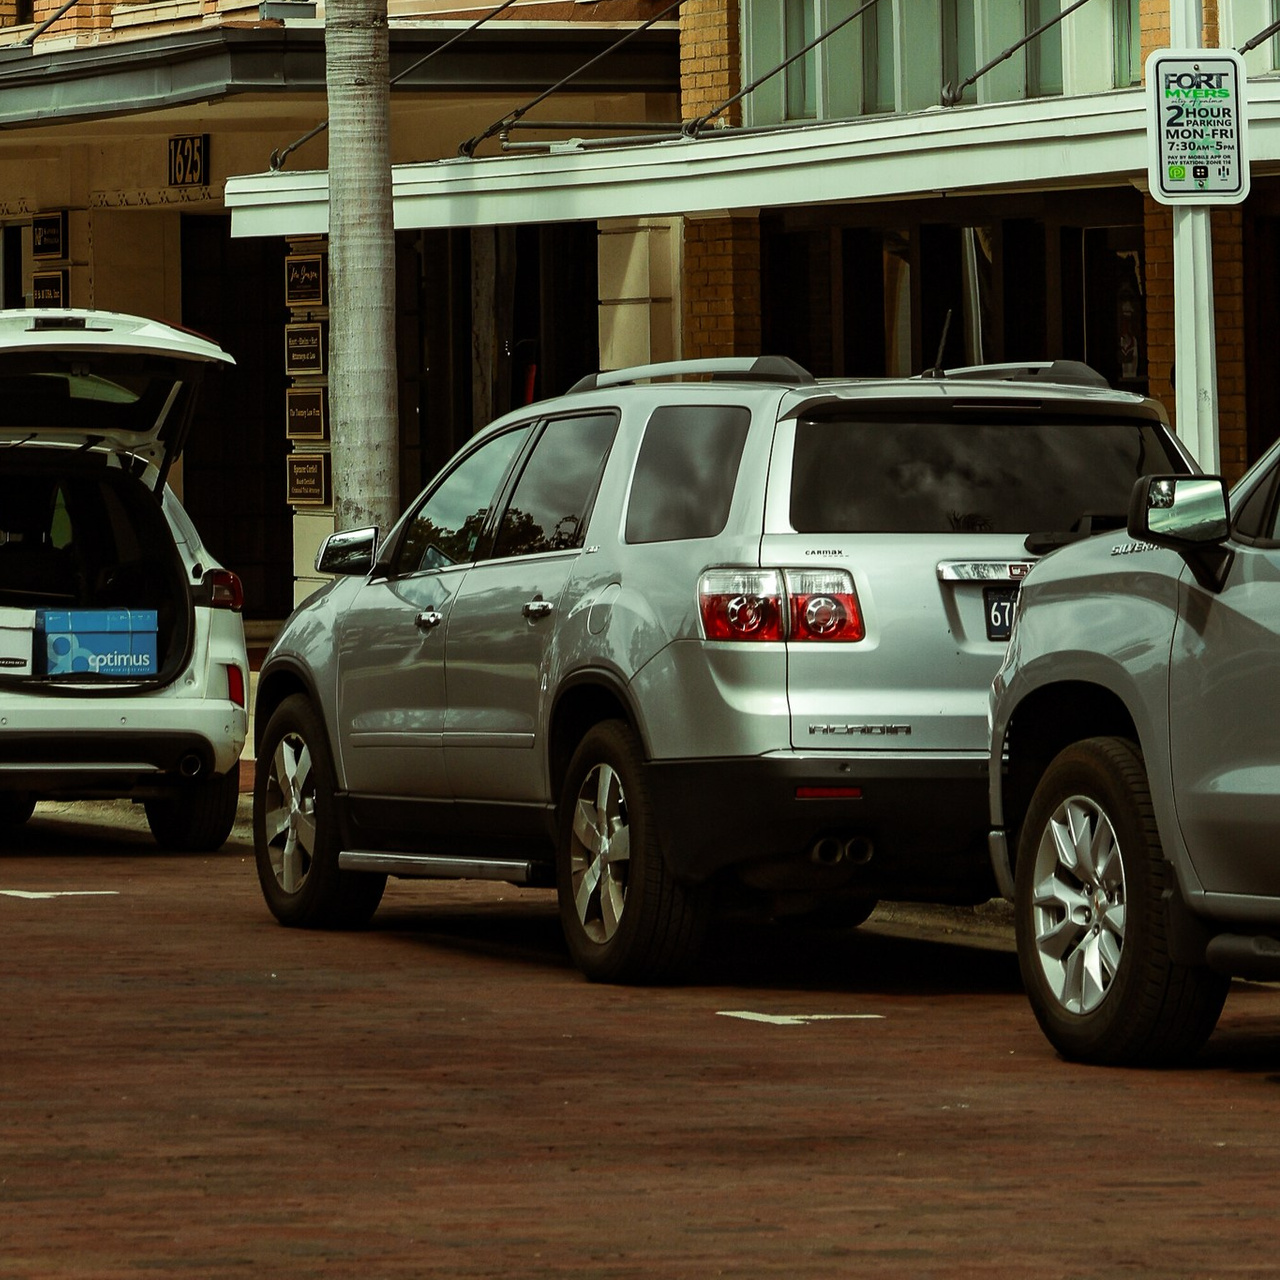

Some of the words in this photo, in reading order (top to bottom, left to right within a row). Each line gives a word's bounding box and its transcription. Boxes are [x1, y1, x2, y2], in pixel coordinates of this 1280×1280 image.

[1164, 73, 1229, 89] FORT
[1165, 88, 1230, 99] MYERS
[1165, 105, 1185, 128] 2
[1185, 107, 1232, 119] HOUR
[1186, 119, 1232, 127] PARKING
[1166, 129, 1233, 139] MON-FRI
[170, 137, 201, 185] 1625
[1110, 541, 1162, 556] SILVER
[990, 602, 1017, 627] 67
[87, 650, 151, 673] optimus
[808, 723, 912, 735] ACADIA
